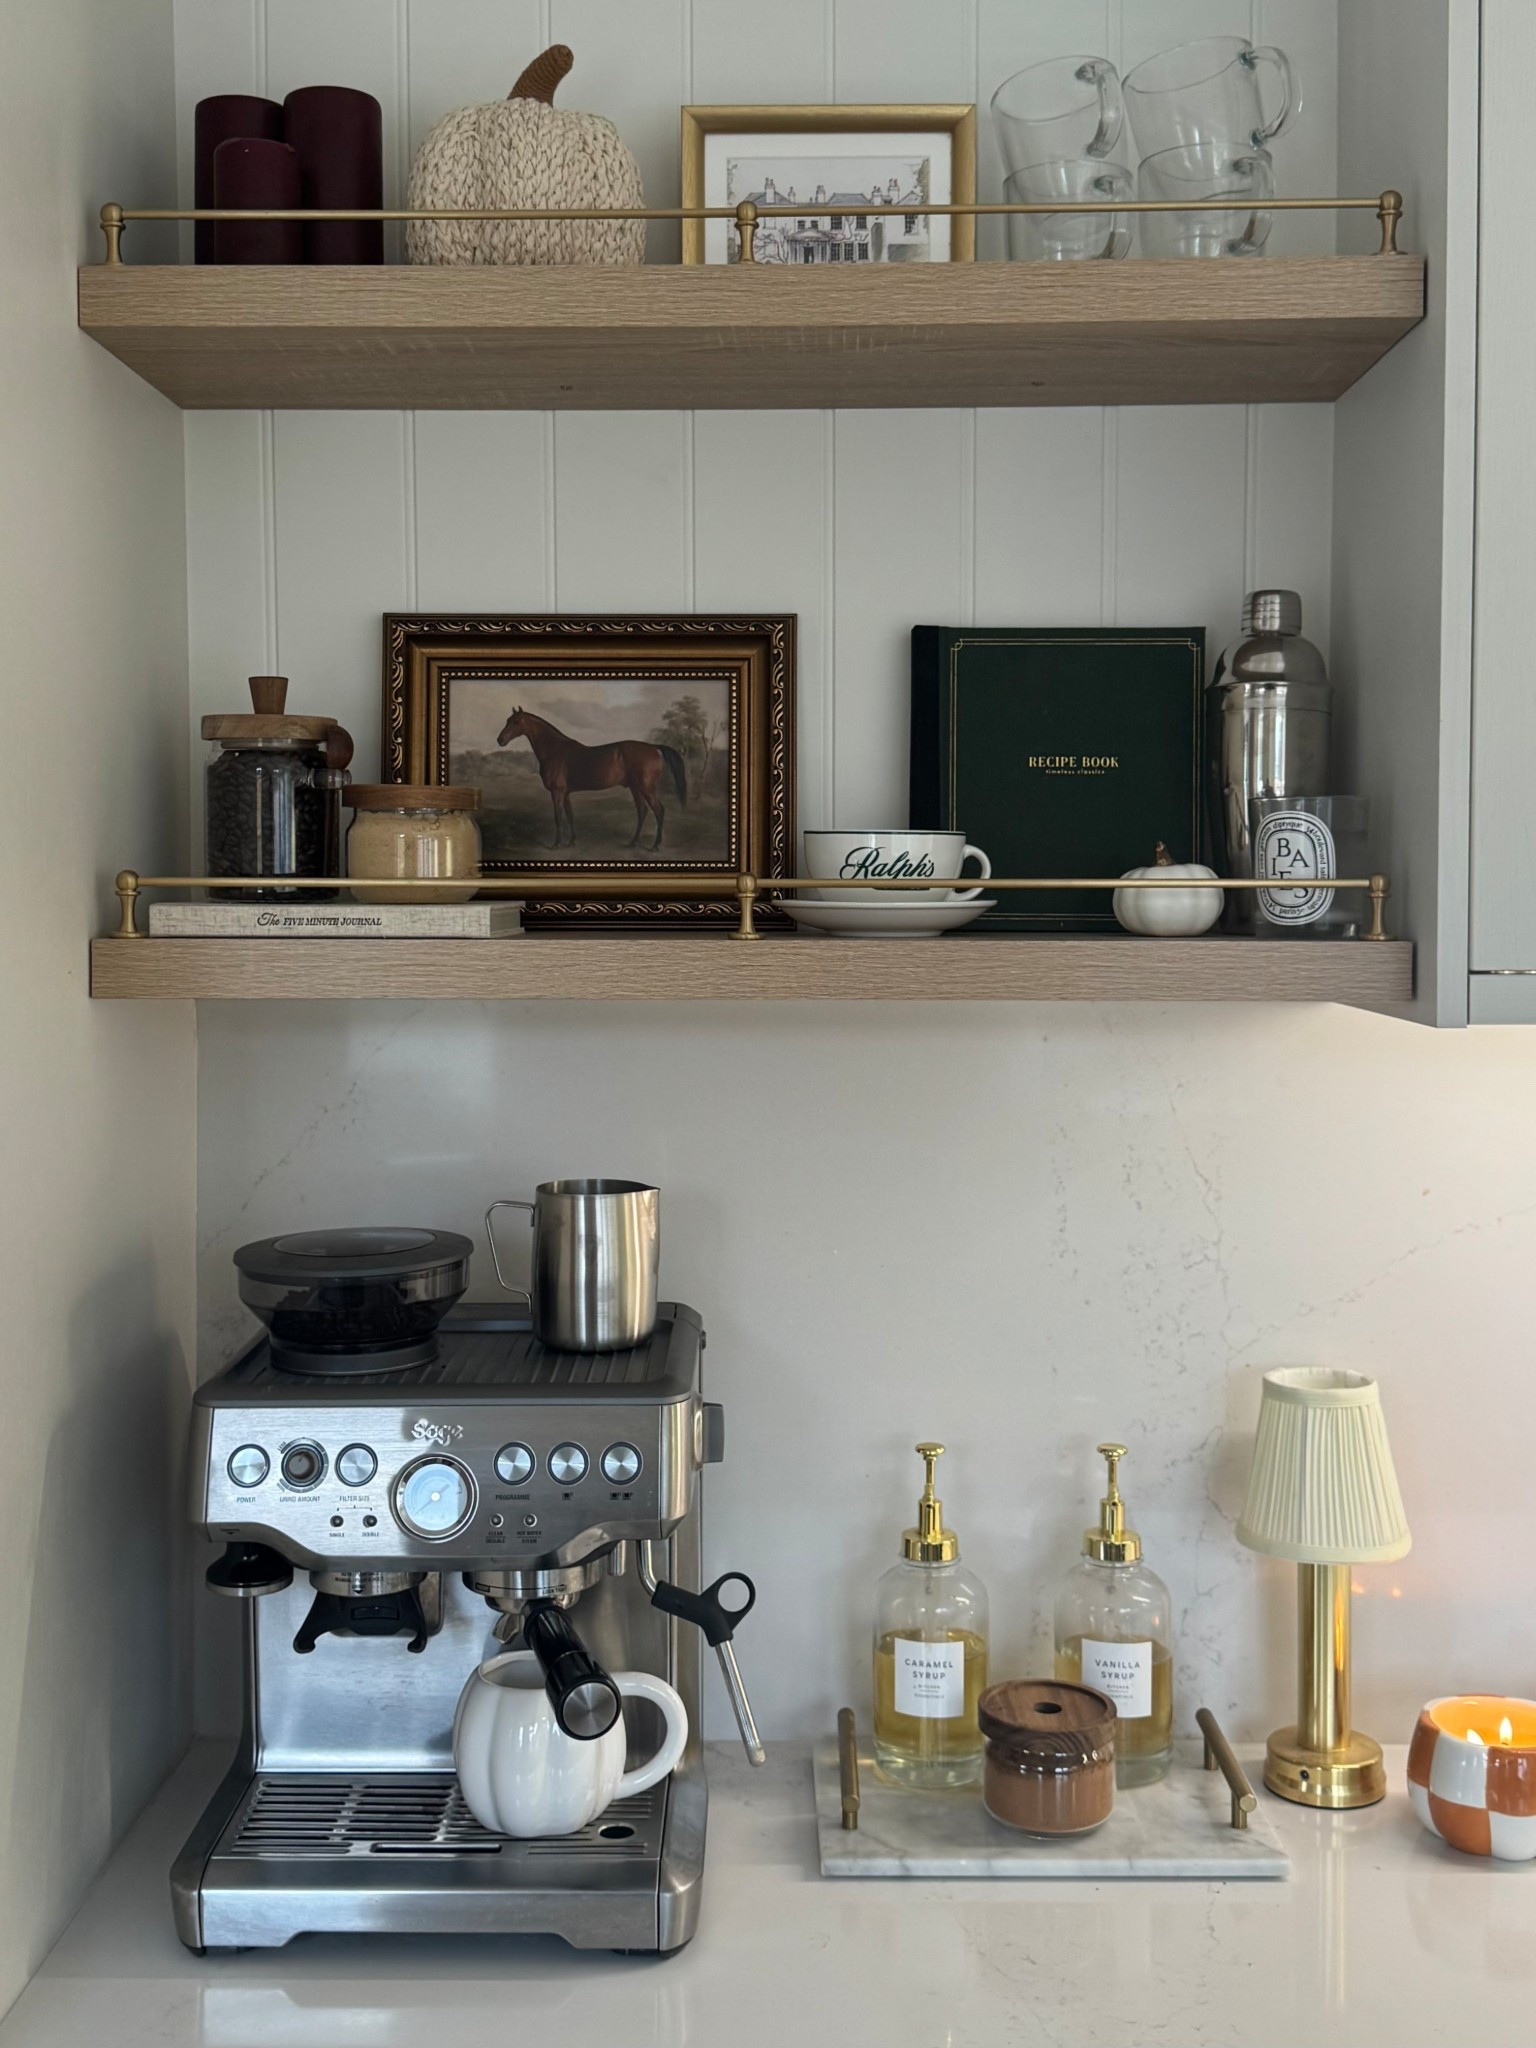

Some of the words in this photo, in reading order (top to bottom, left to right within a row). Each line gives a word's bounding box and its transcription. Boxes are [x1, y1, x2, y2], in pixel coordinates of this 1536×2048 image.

[1028, 756, 1077, 767] RECIPE
[1082, 756, 1119, 767] BOOK
[839, 846, 935, 880] Ralph's
[257, 912, 281, 926] The
[283, 918, 305, 926] FIVE
[305, 918, 340, 926] MINUTE
[340, 918, 383, 926] JOURNAL
[904, 1658, 954, 1668] CARAMEL
[1094, 1659, 1141, 1669] VANILLA
[912, 1670, 946, 1679] SYRUP
[1101, 1671, 1135, 1680] SYRUP
